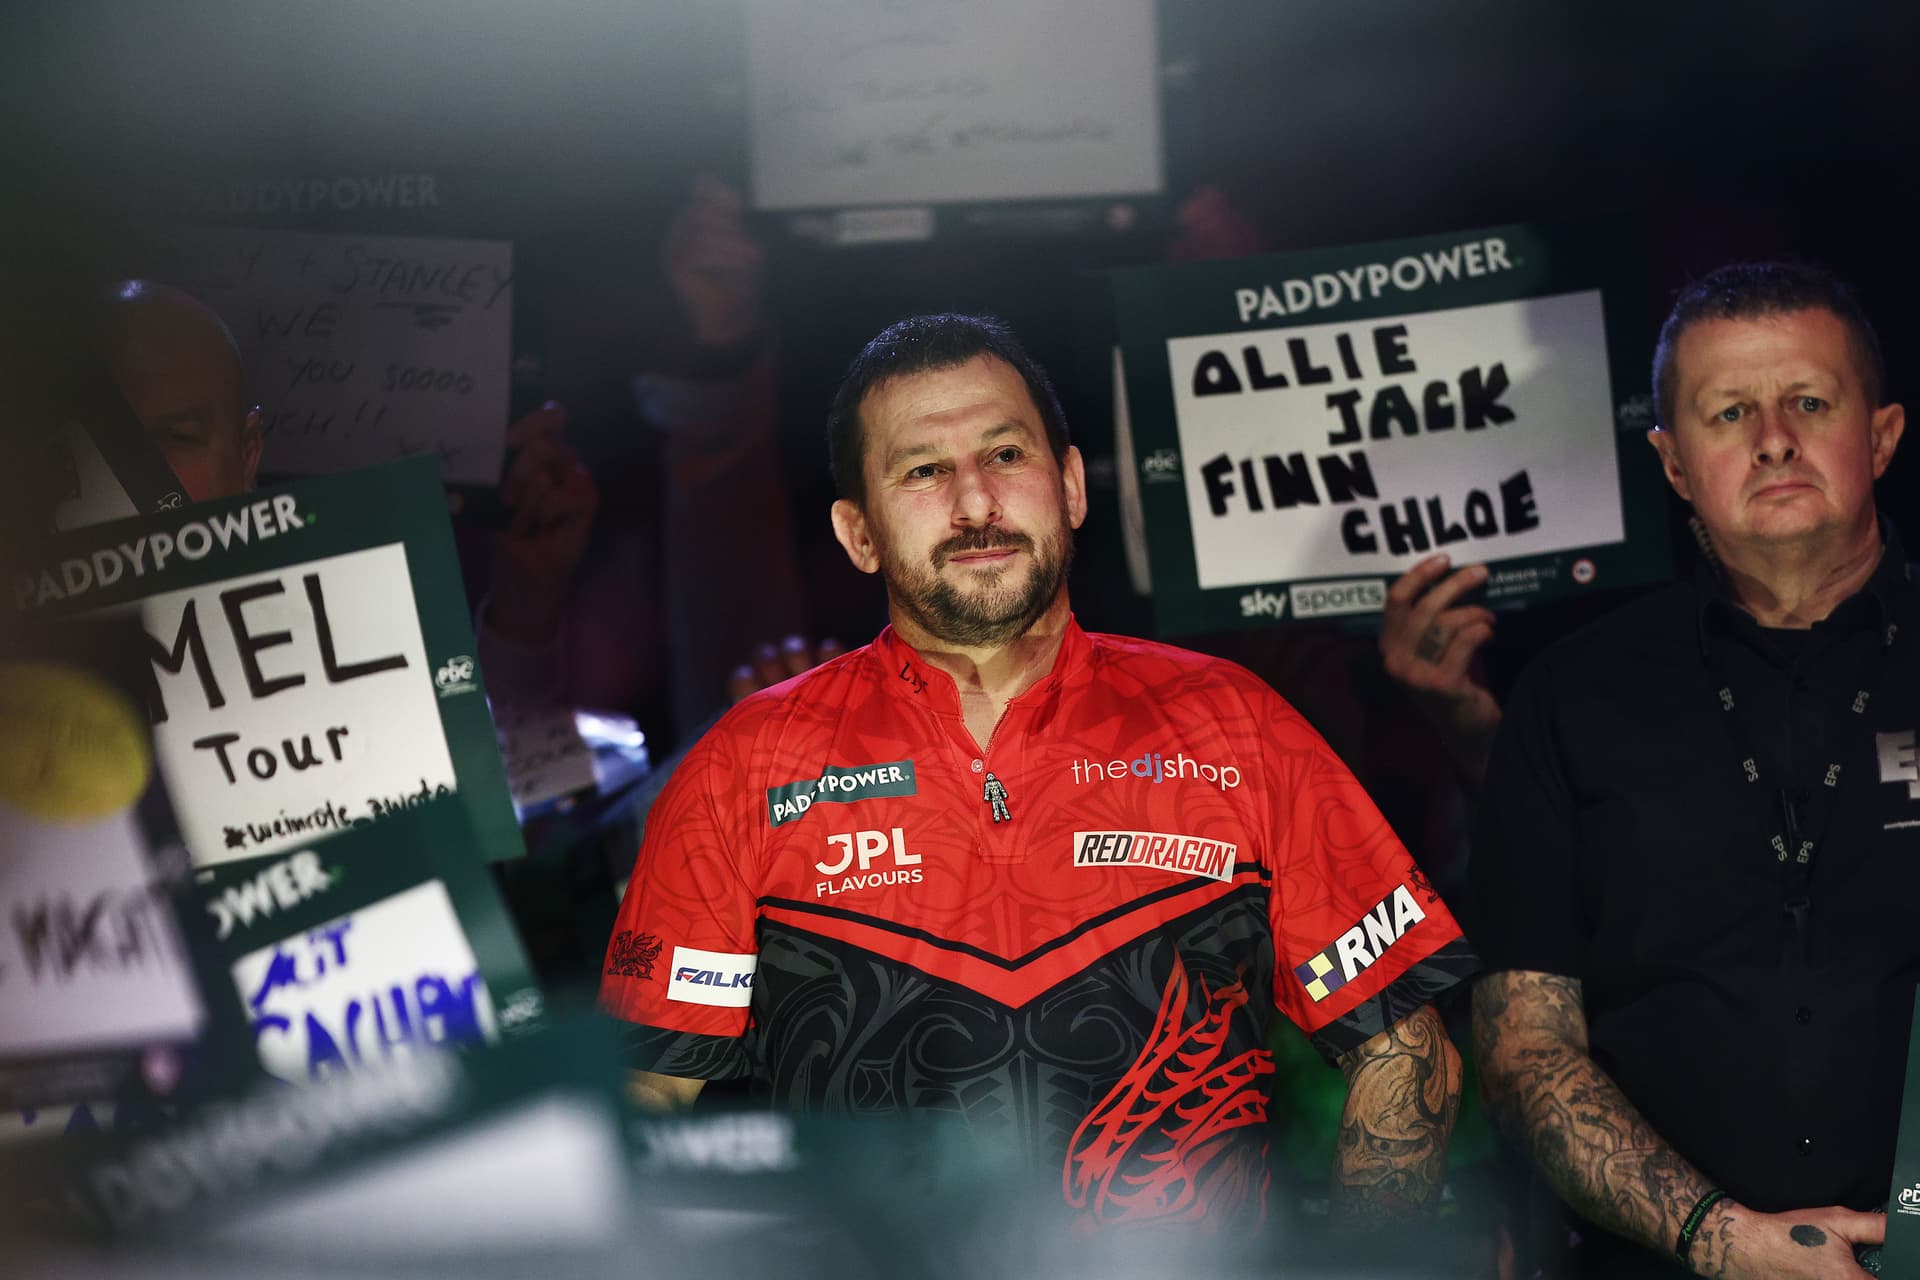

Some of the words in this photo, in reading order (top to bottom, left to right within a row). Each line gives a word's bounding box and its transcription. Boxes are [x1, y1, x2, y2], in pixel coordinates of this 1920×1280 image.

[1192, 324, 1417, 398] OLLIE
[1325, 363, 1516, 446] JACK
[1201, 451, 1379, 517] FINN
[1341, 470, 1540, 558] CHLOE
[1239, 588, 1288, 619] sky
[1297, 584, 1383, 613] sports
[1719, 687, 1735, 711] EPS
[1852, 690, 1870, 713] EPS
[193, 725, 350, 786] Tour
[1743, 758, 1759, 783] EPS
[1824, 763, 1841, 787] EPS
[815, 827, 922, 875] JPL
[1771, 834, 1788, 861] EPS
[1797, 840, 1814, 864] EPS
[816, 868, 924, 898] FLAVOURS
[1335, 884, 1426, 982] RNA
[675, 967, 756, 989] FALK
